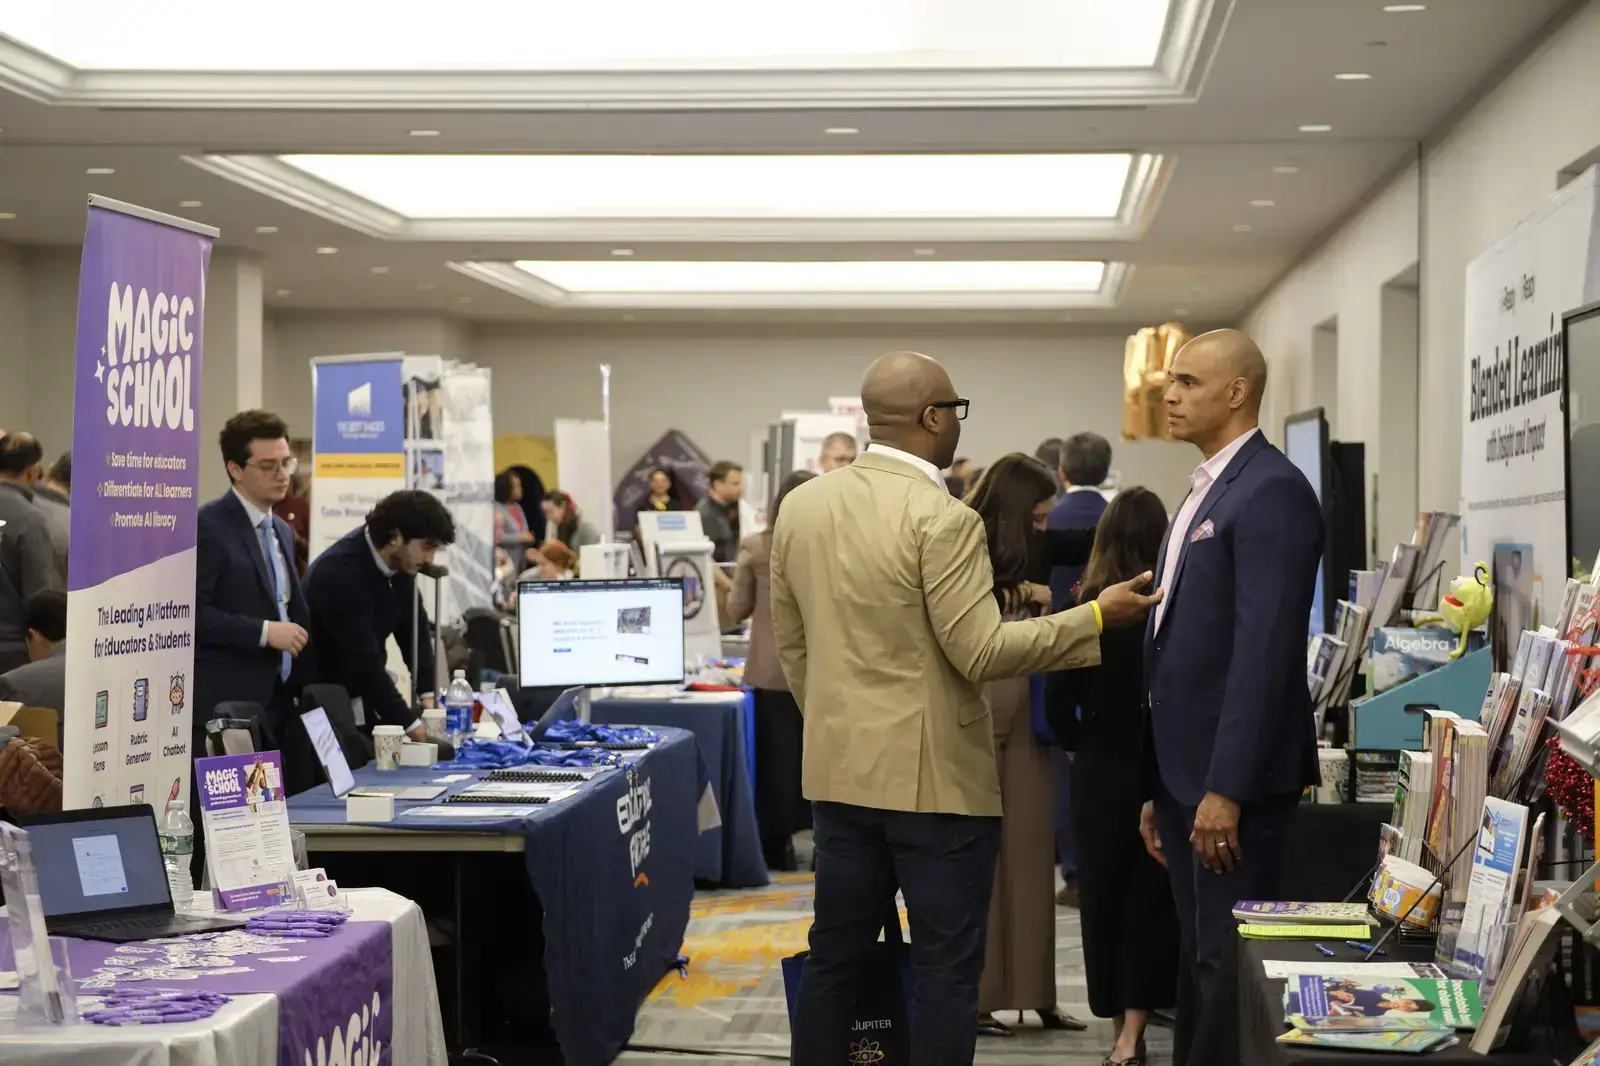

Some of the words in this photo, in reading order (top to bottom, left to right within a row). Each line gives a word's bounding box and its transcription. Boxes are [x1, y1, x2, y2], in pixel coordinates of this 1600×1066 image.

[1470, 338, 1512, 423] Blended
[1513, 311, 1563, 414] Learnin
[106, 354, 194, 432] SCHOOL
[111, 452, 125, 468] Save
[126, 451, 142, 468] time
[142, 452, 153, 468] for
[154, 453, 187, 470] educators
[103, 480, 142, 498] Differentiate
[143, 481, 154, 498] for
[163, 483, 193, 498] learners
[114, 512, 144, 527] Promote
[144, 512, 152, 527] AI
[153, 513, 177, 531] literacy
[98, 607, 109, 626] The
[110, 604, 144, 628] Leading
[146, 602, 155, 622] AI
[155, 600, 190, 621] Platform
[94, 637, 104, 658] for
[104, 632, 147, 657] Educators
[148, 635, 154, 652] &
[154, 630, 191, 651] Students
[1383, 634, 1449, 653] Algebra
[130, 731, 148, 746] Rubric
[171, 726, 179, 738] AI
[92, 740, 109, 755] Lesson
[162, 742, 186, 758] Chatbot
[92, 761, 106, 773] Plans
[125, 750, 152, 767] Generator
[207, 778, 241, 795] SCHOOL
[851, 1019, 892, 1031] JUPITER
